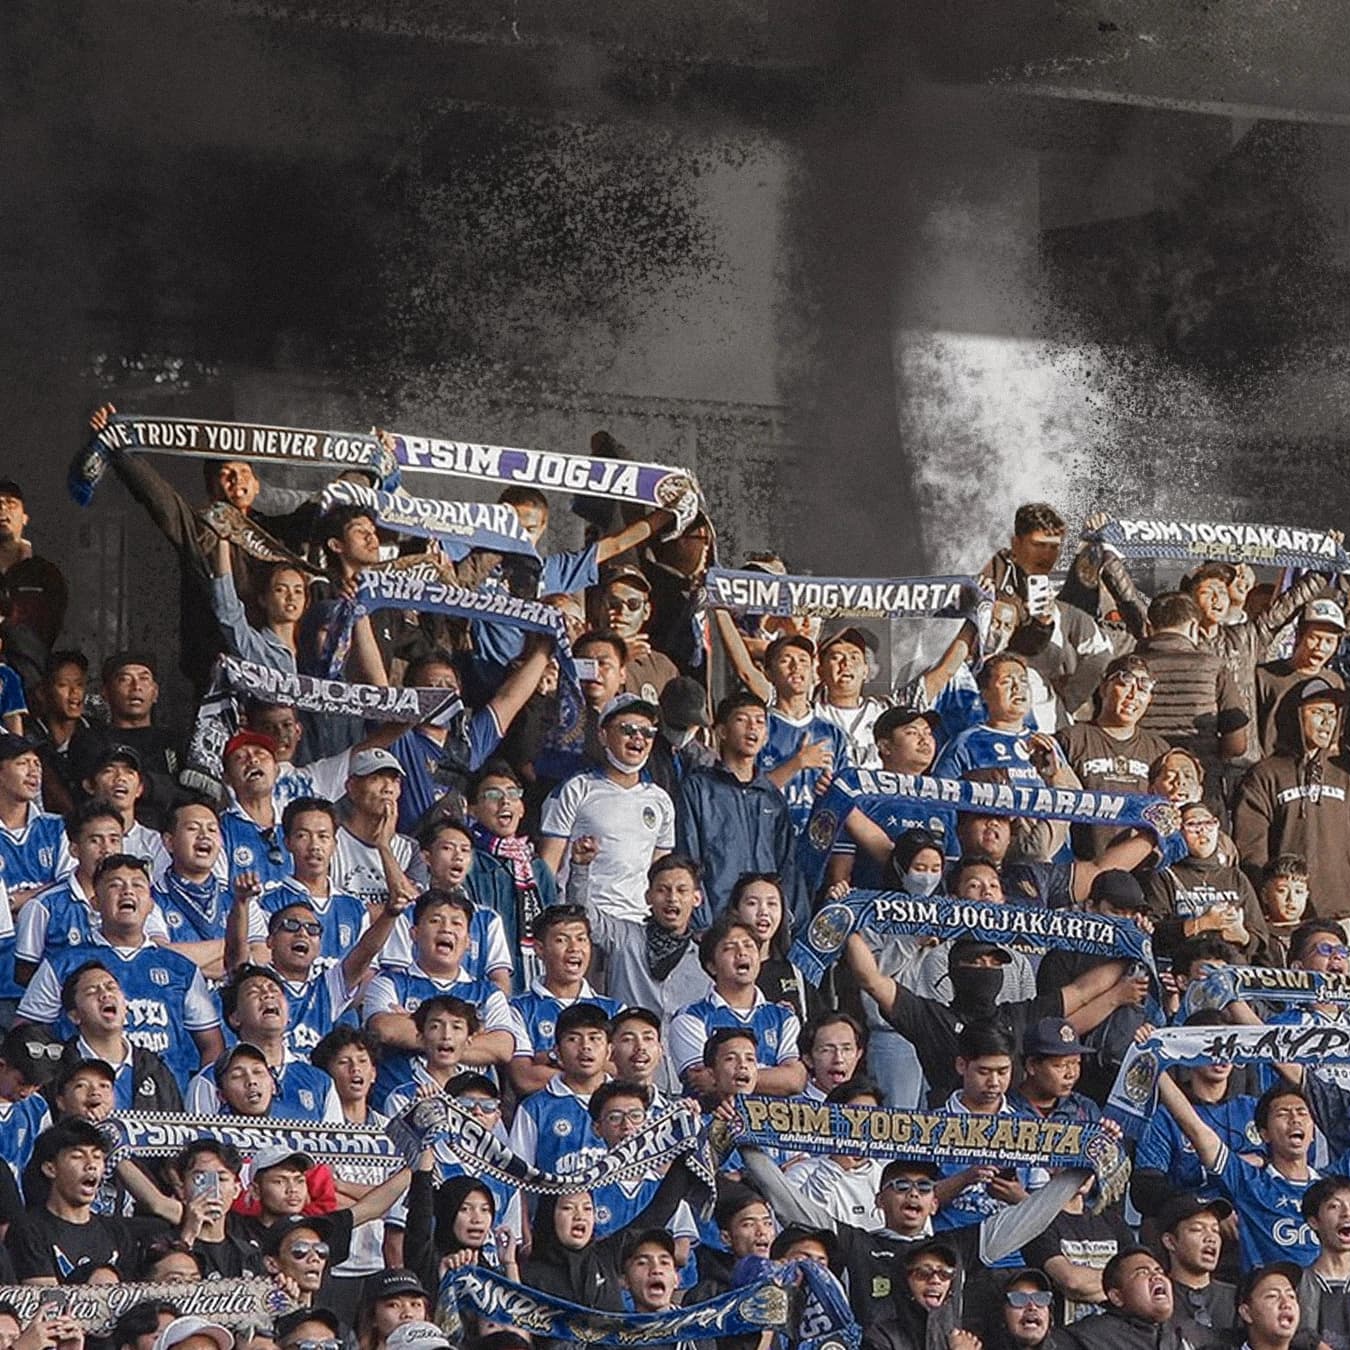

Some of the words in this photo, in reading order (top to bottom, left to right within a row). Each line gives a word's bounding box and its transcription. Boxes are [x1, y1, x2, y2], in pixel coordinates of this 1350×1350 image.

[99, 423, 133, 451] WE
[133, 422, 200, 448] TRUST
[205, 427, 246, 451] YOU
[252, 429, 318, 457] NEVER
[322, 436, 377, 464] LOSE
[401, 435, 500, 476] PSIM
[513, 452, 640, 497] JOGJA
[321, 480, 379, 511] SIM
[1119, 520, 1182, 543] PSIM
[1187, 523, 1336, 556] YOGYAKARTA
[716, 577, 780, 607] PSIM
[788, 582, 962, 611] YOGYAKARTA
[306, 678, 420, 716] JOGJA
[833, 771, 961, 802] LASKAR
[970, 782, 1125, 820] MATARAM
[874, 899, 946, 925] PSIM
[948, 903, 1117, 944] JOGJAKARTA
[1237, 967, 1310, 989] PSIM
[446, 1105, 514, 1171] PSIM
[745, 1099, 831, 1135] PSIM
[841, 1107, 1084, 1155] YOGYAKARTA
[779, 1132, 834, 1146] untukmu
[836, 1138, 867, 1150] yang
[869, 1139, 894, 1150] aku
[933, 1144, 950, 1156] ini
[953, 1147, 997, 1159] caraku
[999, 1149, 1050, 1163] bahagia
